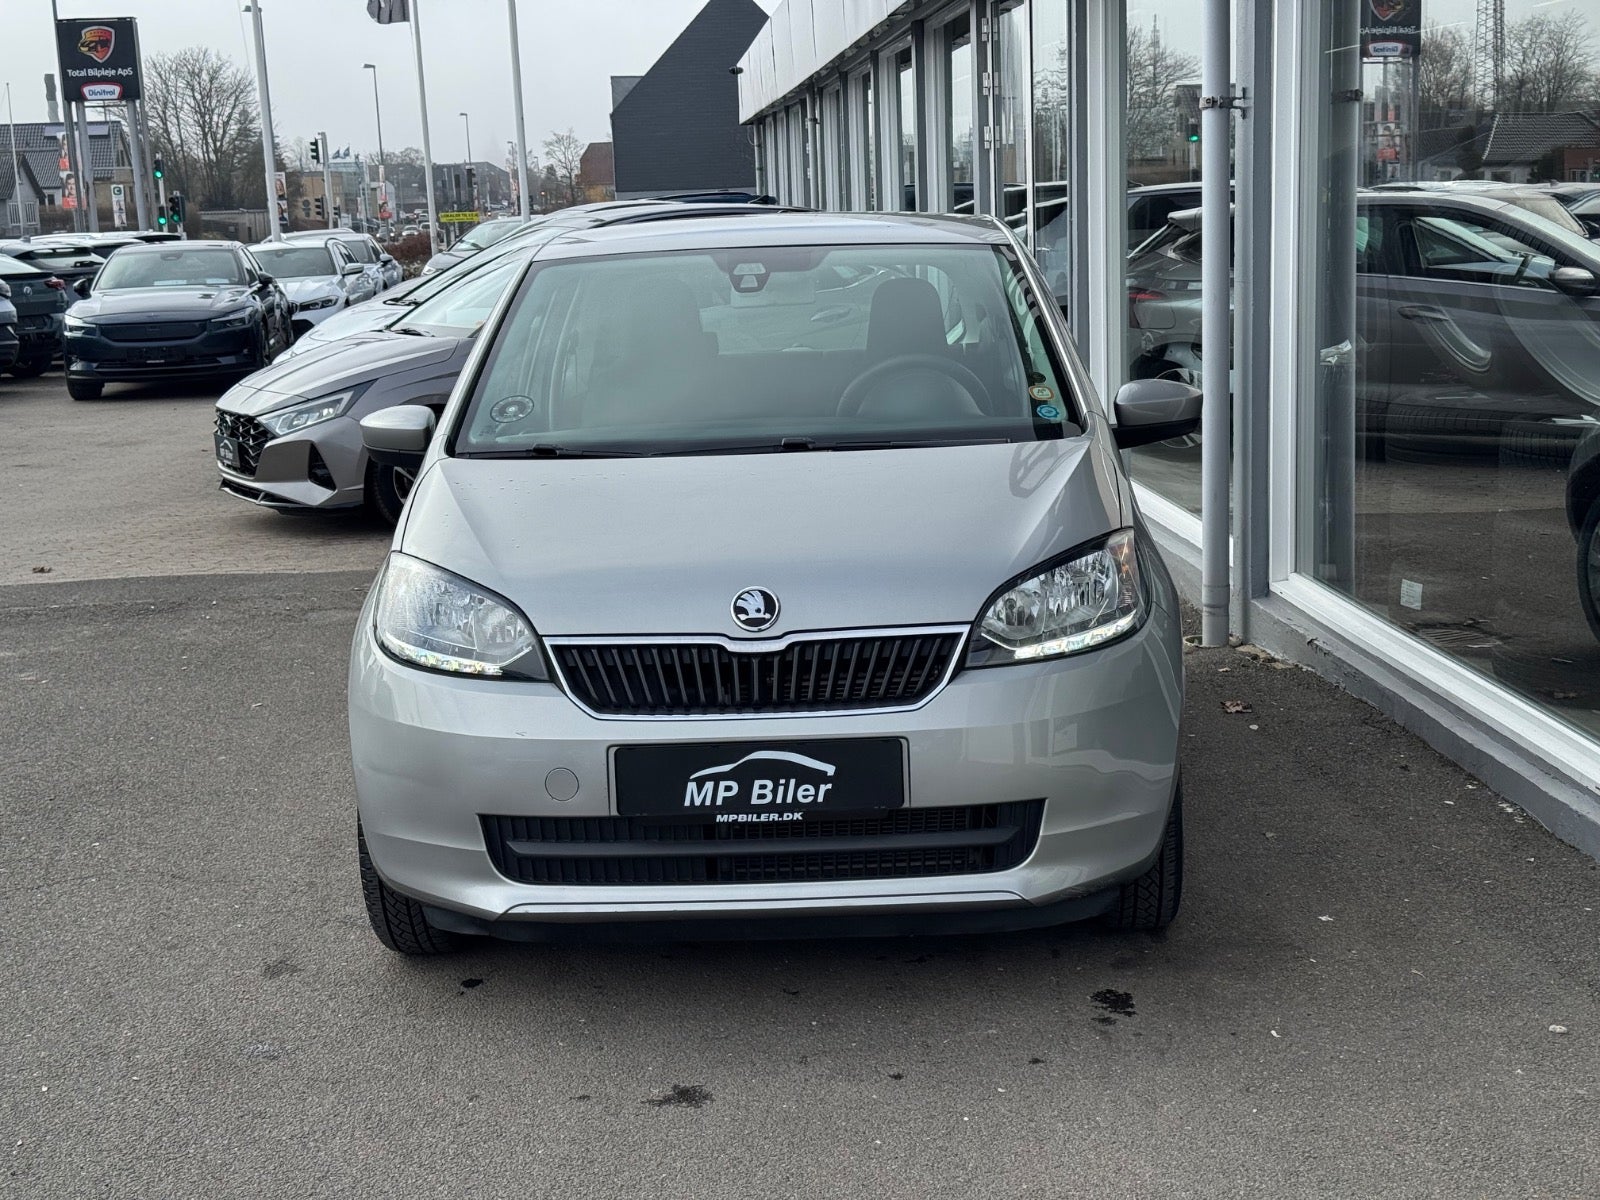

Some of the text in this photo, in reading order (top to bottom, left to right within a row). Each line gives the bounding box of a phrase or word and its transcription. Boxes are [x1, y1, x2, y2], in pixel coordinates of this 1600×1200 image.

[67, 67, 133, 77] Total Bilpleje ApS
[684, 778, 832, 806] MP Biler
[716, 812, 803, 823] MPBILER.DK
